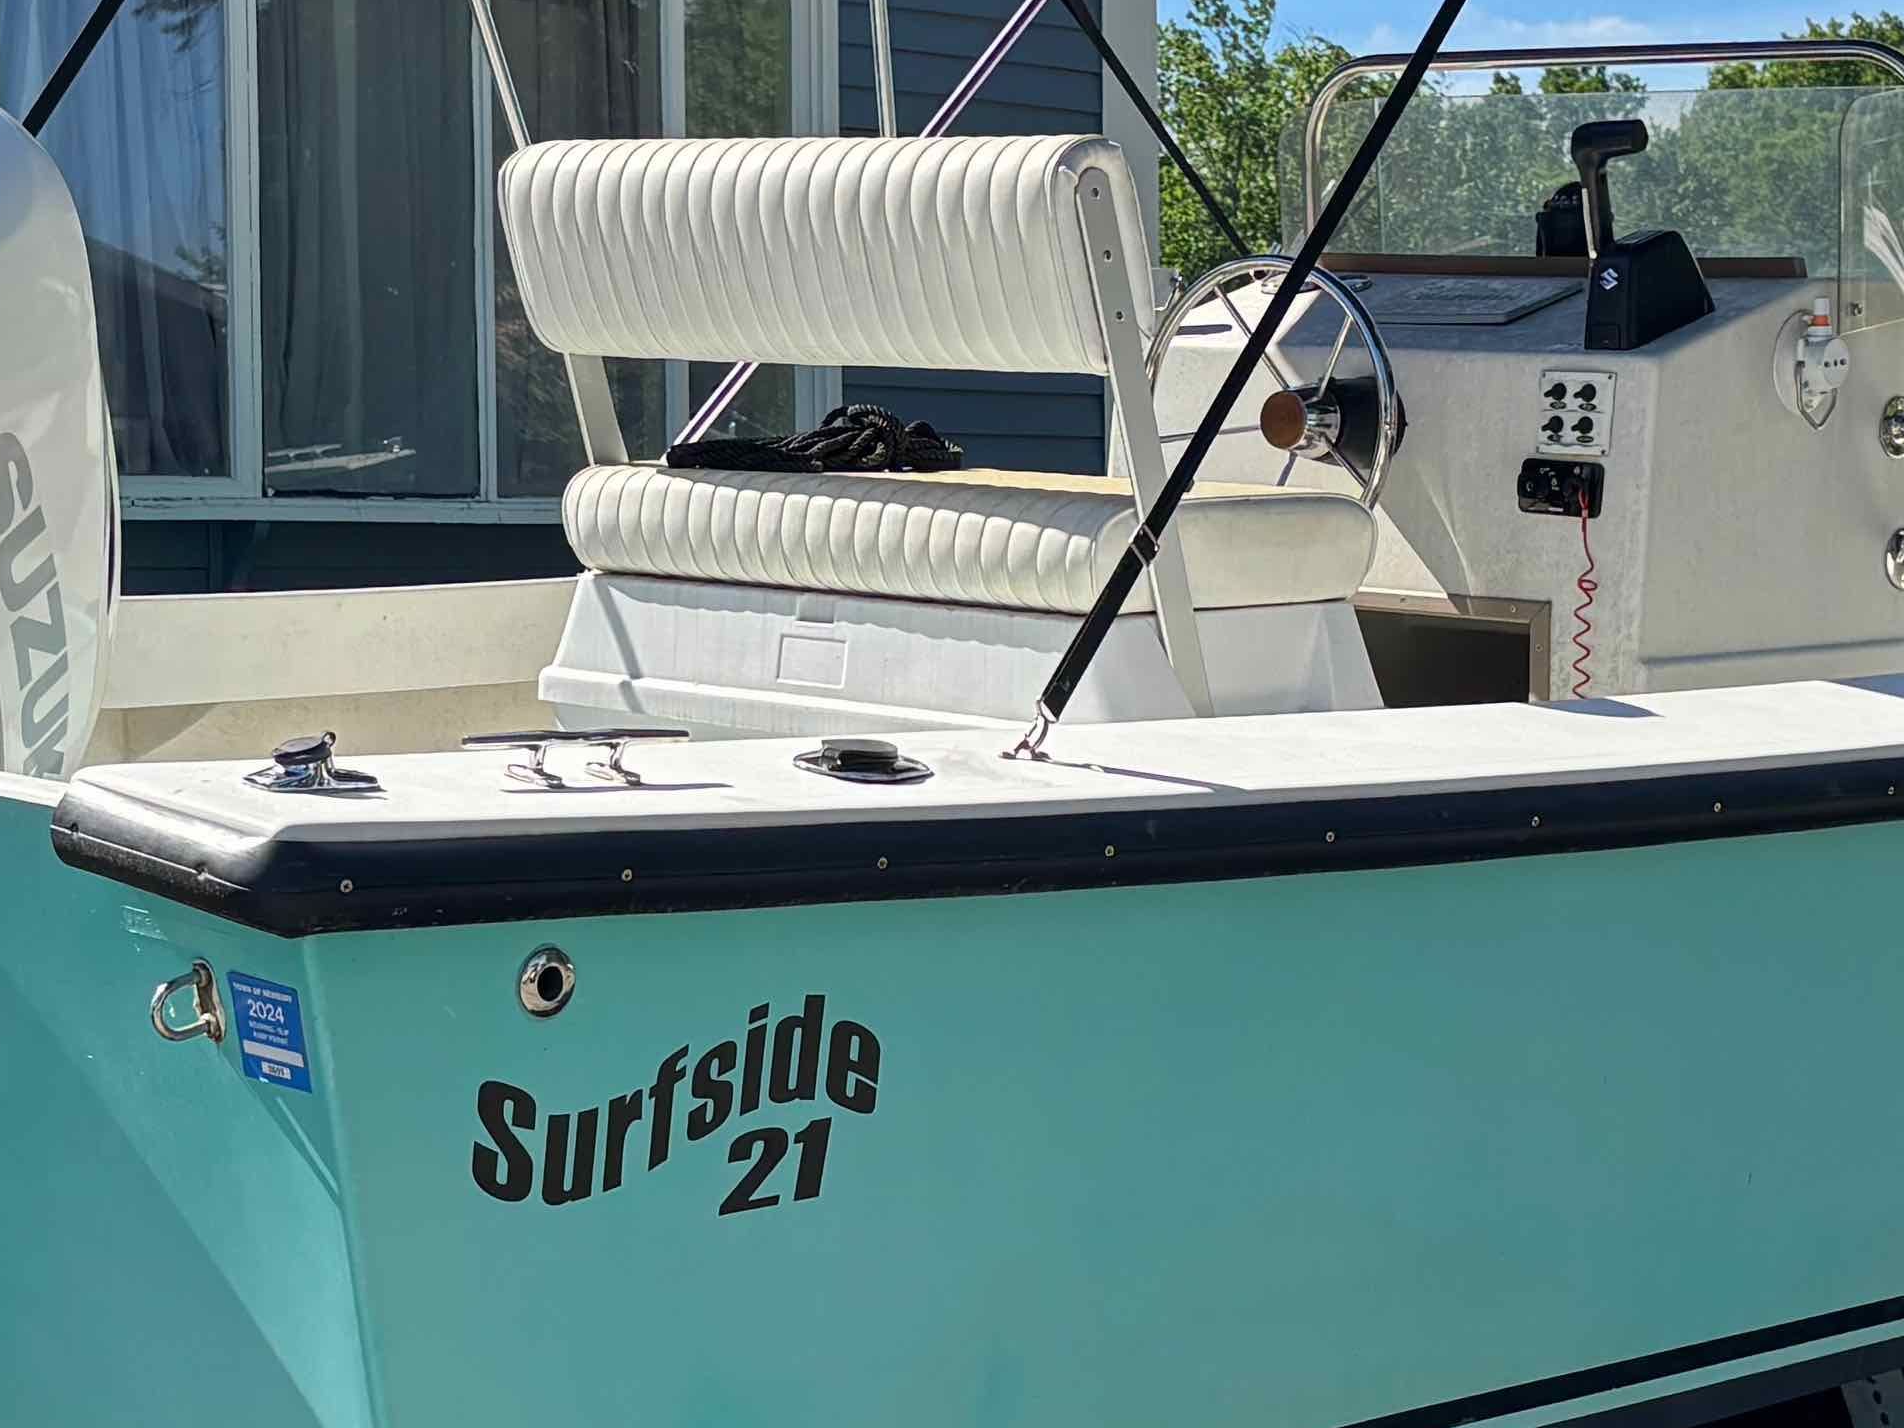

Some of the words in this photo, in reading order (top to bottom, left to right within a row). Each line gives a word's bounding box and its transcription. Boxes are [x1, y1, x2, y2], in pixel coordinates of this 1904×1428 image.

[248, 999, 285, 1024] 2024
[472, 994, 881, 1207] Surfside
[718, 1117, 833, 1217] 21
